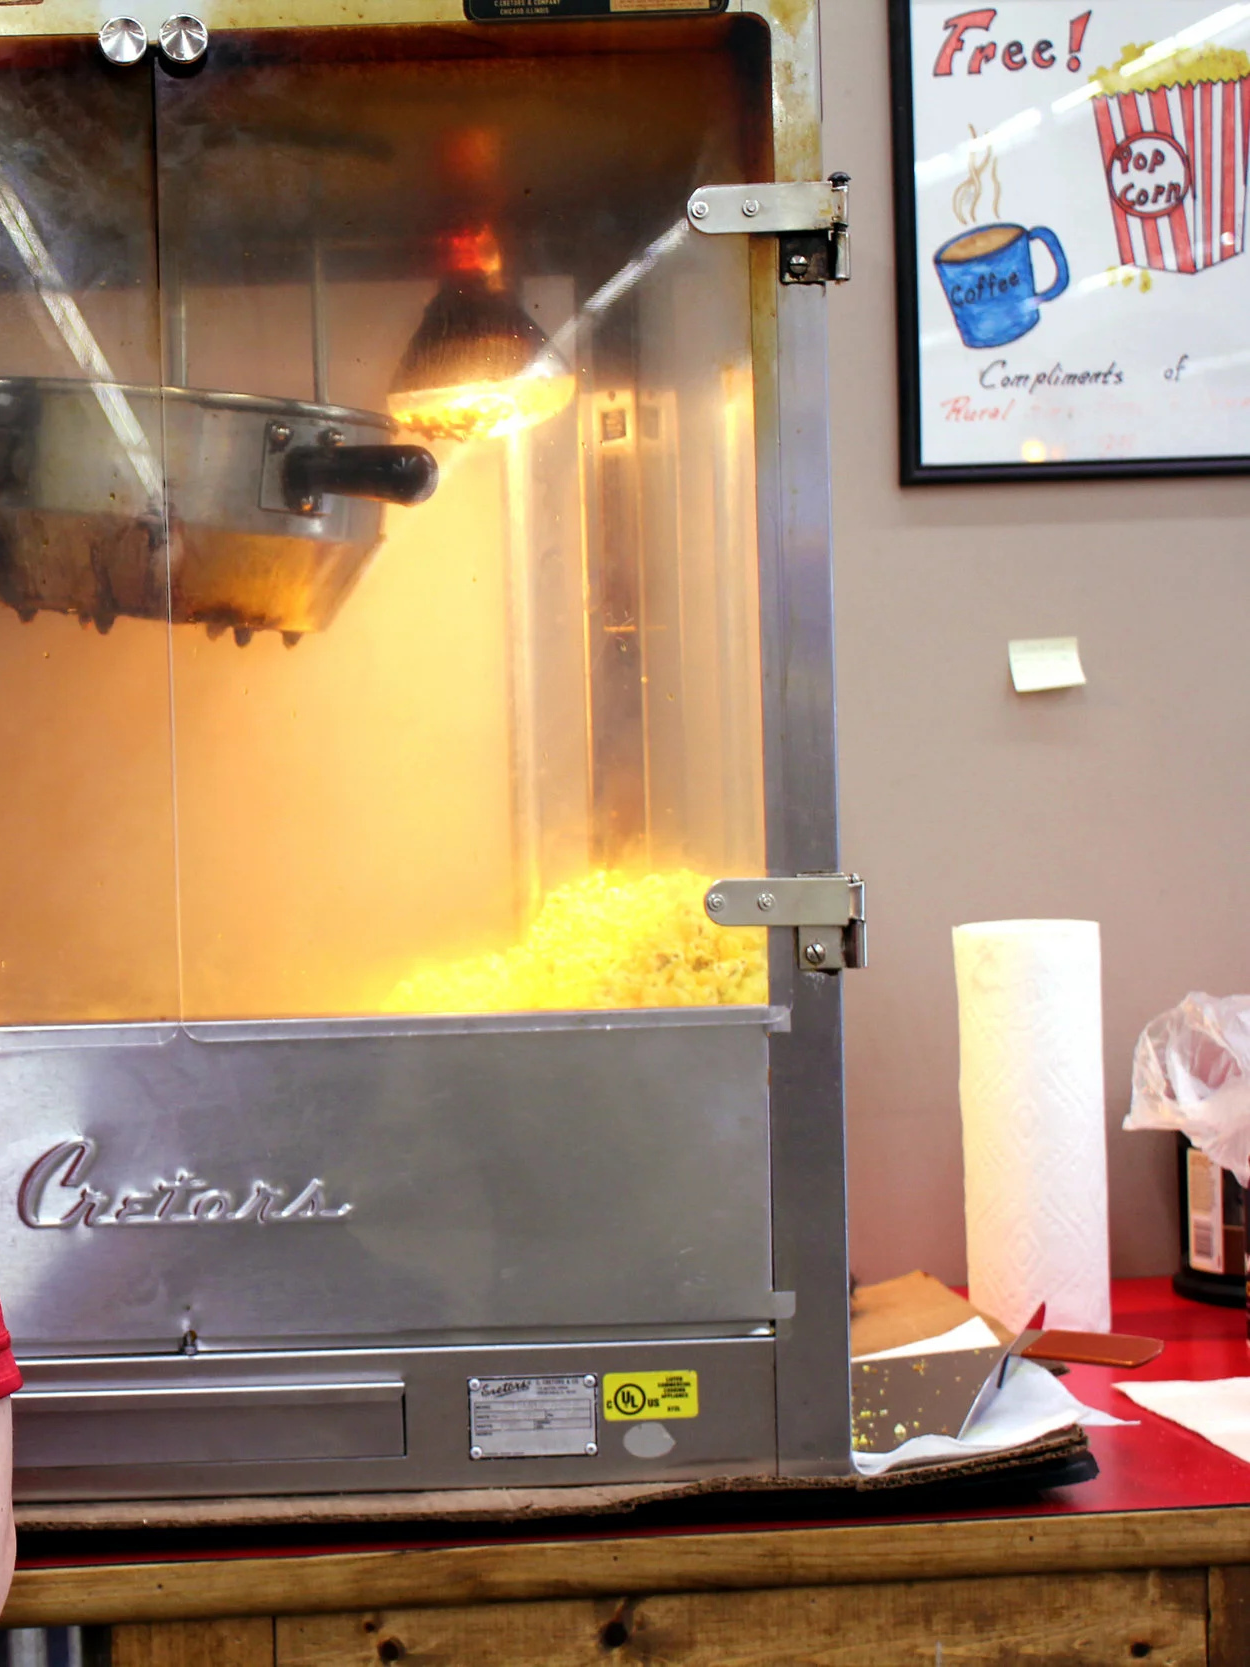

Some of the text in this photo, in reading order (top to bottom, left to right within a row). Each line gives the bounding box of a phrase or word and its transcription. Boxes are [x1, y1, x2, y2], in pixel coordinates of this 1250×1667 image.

[932, 7, 1093, 77] Free!
[950, 271, 1020, 308] Coffee
[979, 354, 1189, 394] Compliments of
[940, 396, 1016, 422] Rural
[17, 1135, 354, 1228] Cretors
[621, 1390, 638, 1408] UL
